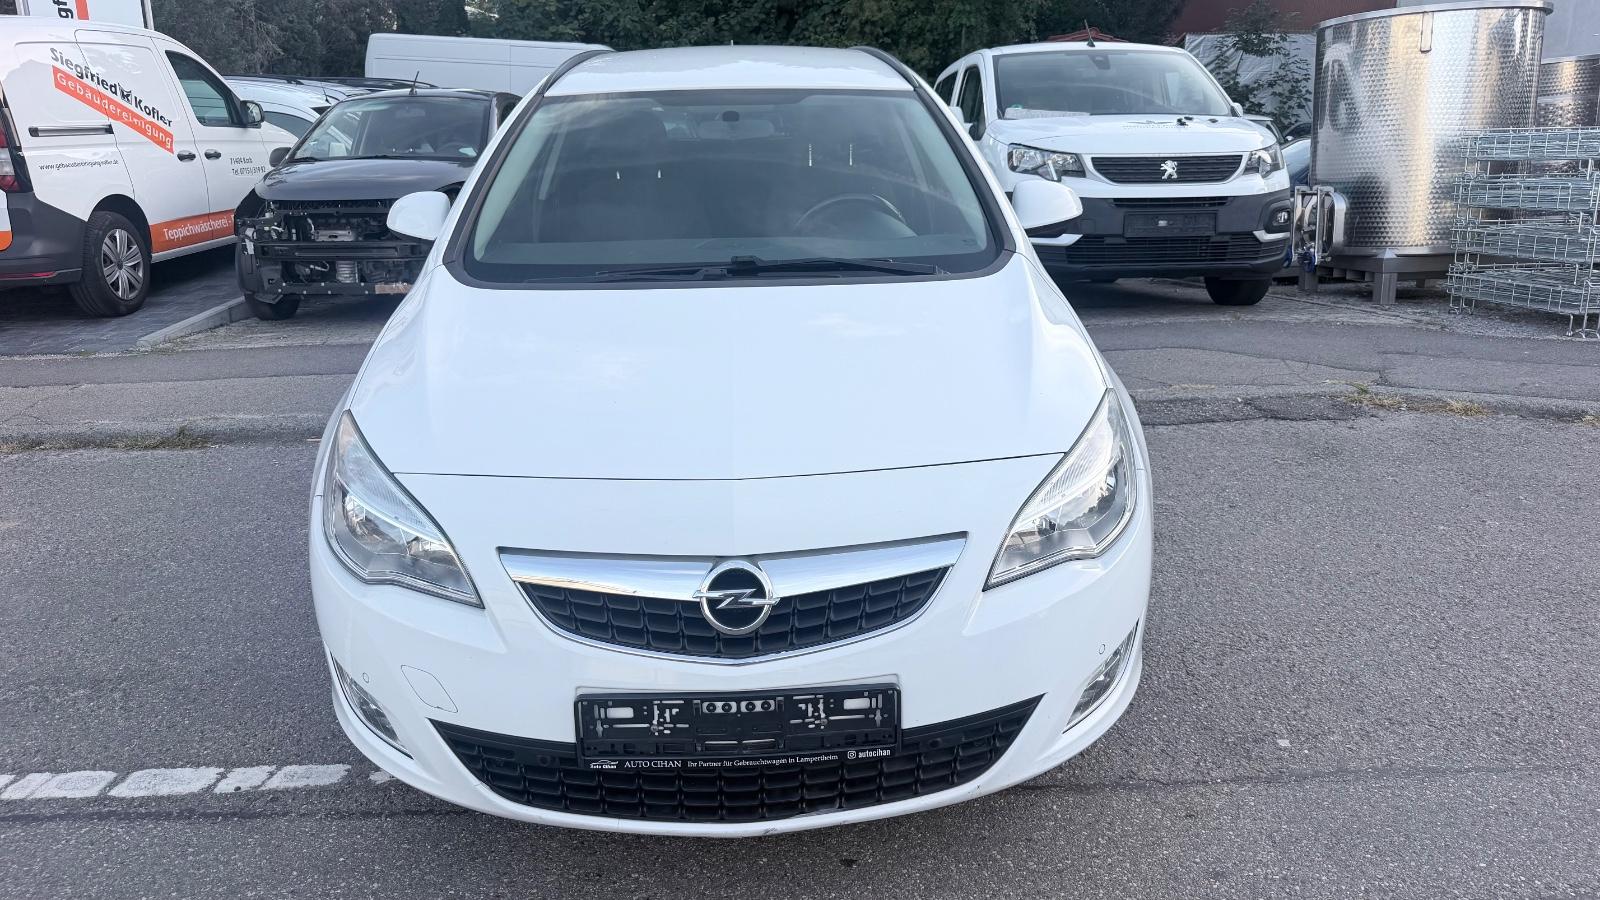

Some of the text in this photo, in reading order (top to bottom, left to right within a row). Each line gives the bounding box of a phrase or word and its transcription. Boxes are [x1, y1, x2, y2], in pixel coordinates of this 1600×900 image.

[50, 47, 117, 95] Siegfried
[134, 96, 172, 127] Kofler
[57, 73, 172, 148] Gebäudereinigung
[163, 217, 229, 241] Teppichwäscherei
[624, 760, 650, 768] AUTO
[651, 760, 682, 768] CIHAN
[733, 758, 788, 766] Gebrauchtwagen
[796, 754, 838, 763] Lampertheim
[858, 748, 891, 758] autocihan
